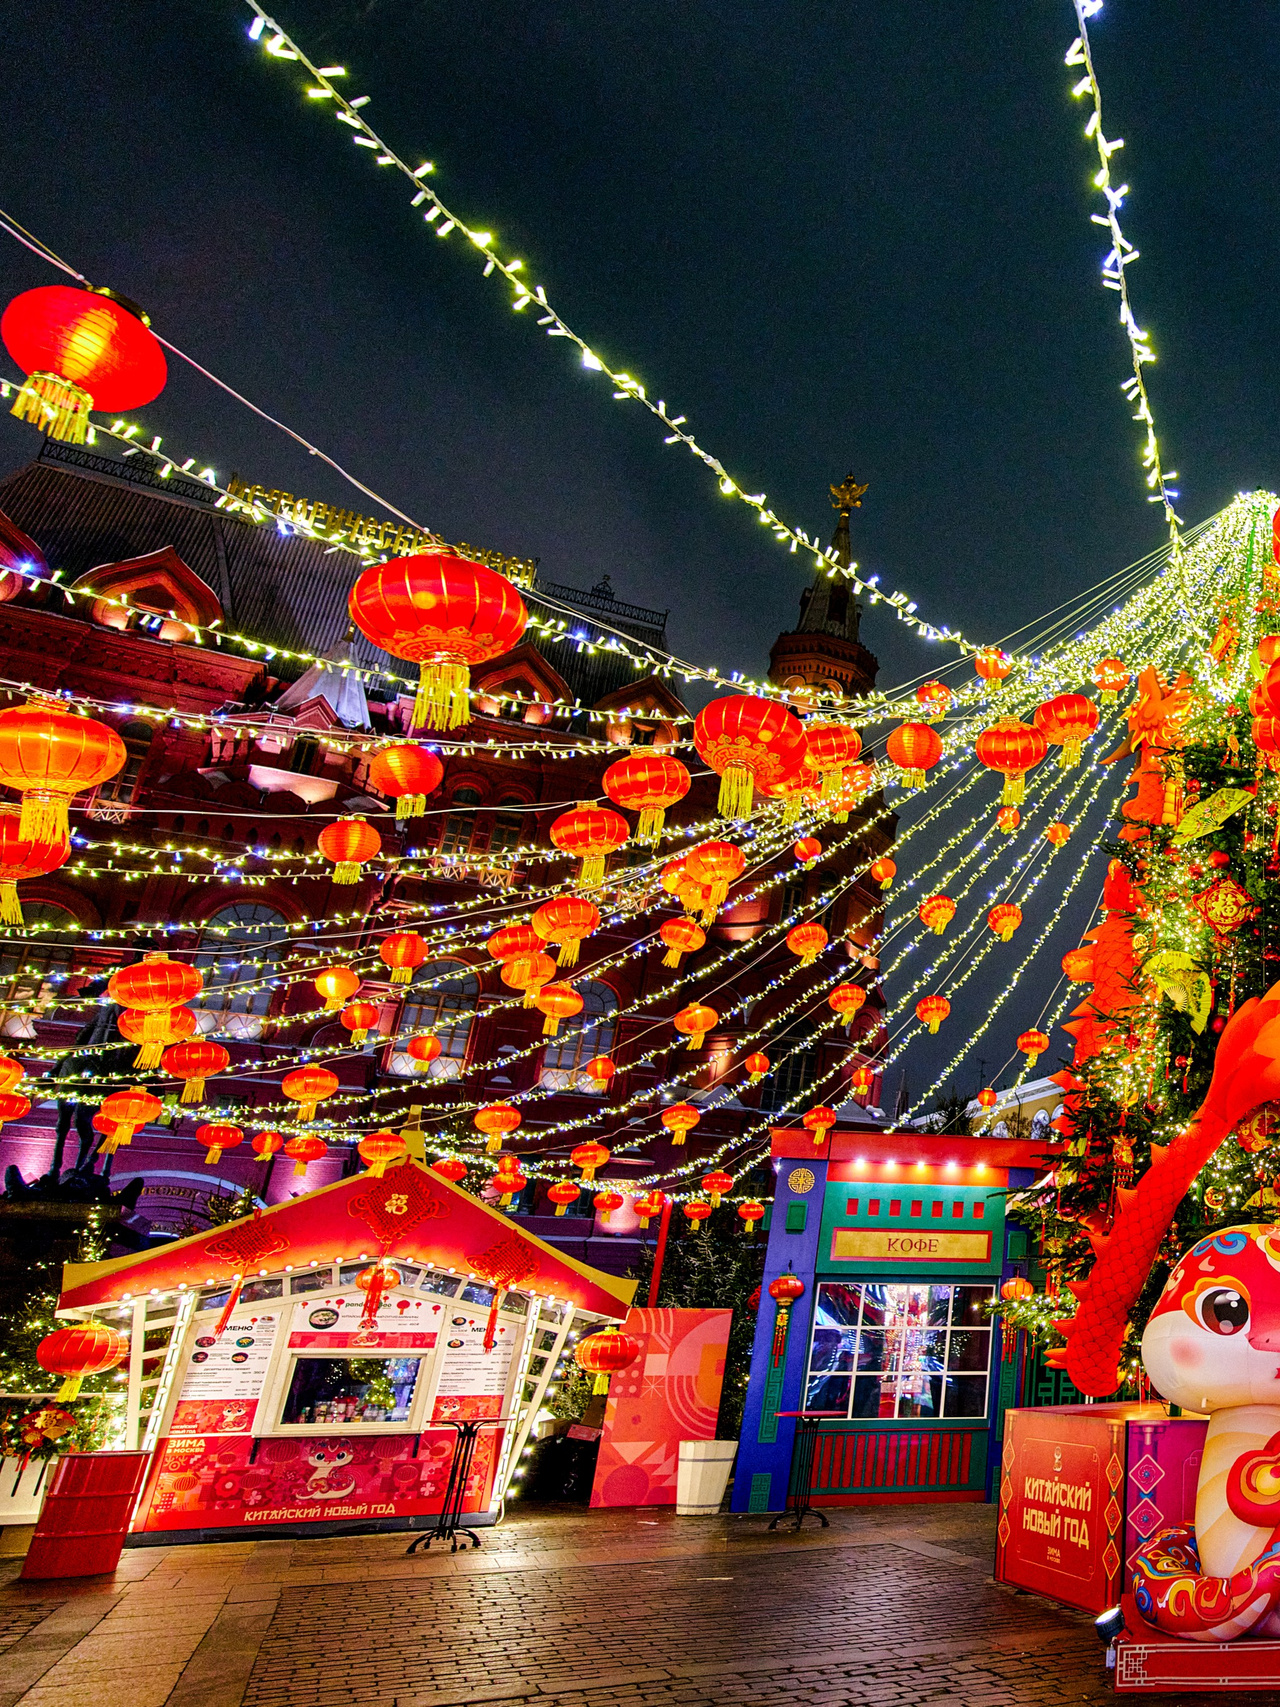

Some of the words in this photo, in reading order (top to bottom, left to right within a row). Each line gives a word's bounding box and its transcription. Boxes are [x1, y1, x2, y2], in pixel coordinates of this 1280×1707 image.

[887, 1238, 939, 1252] КОФЕ
[168, 1439, 205, 1448] ЗИМА
[1024, 1476, 1092, 1512] КИТАЙСКИЙ
[244, 1505, 320, 1521] КИТАЙСКИЙ
[324, 1503, 368, 1516] НОВЫЙ
[370, 1503, 395, 1515] ГОД
[1022, 1507, 1061, 1538] НОВЫЙ
[1064, 1516, 1089, 1550] ГОД
